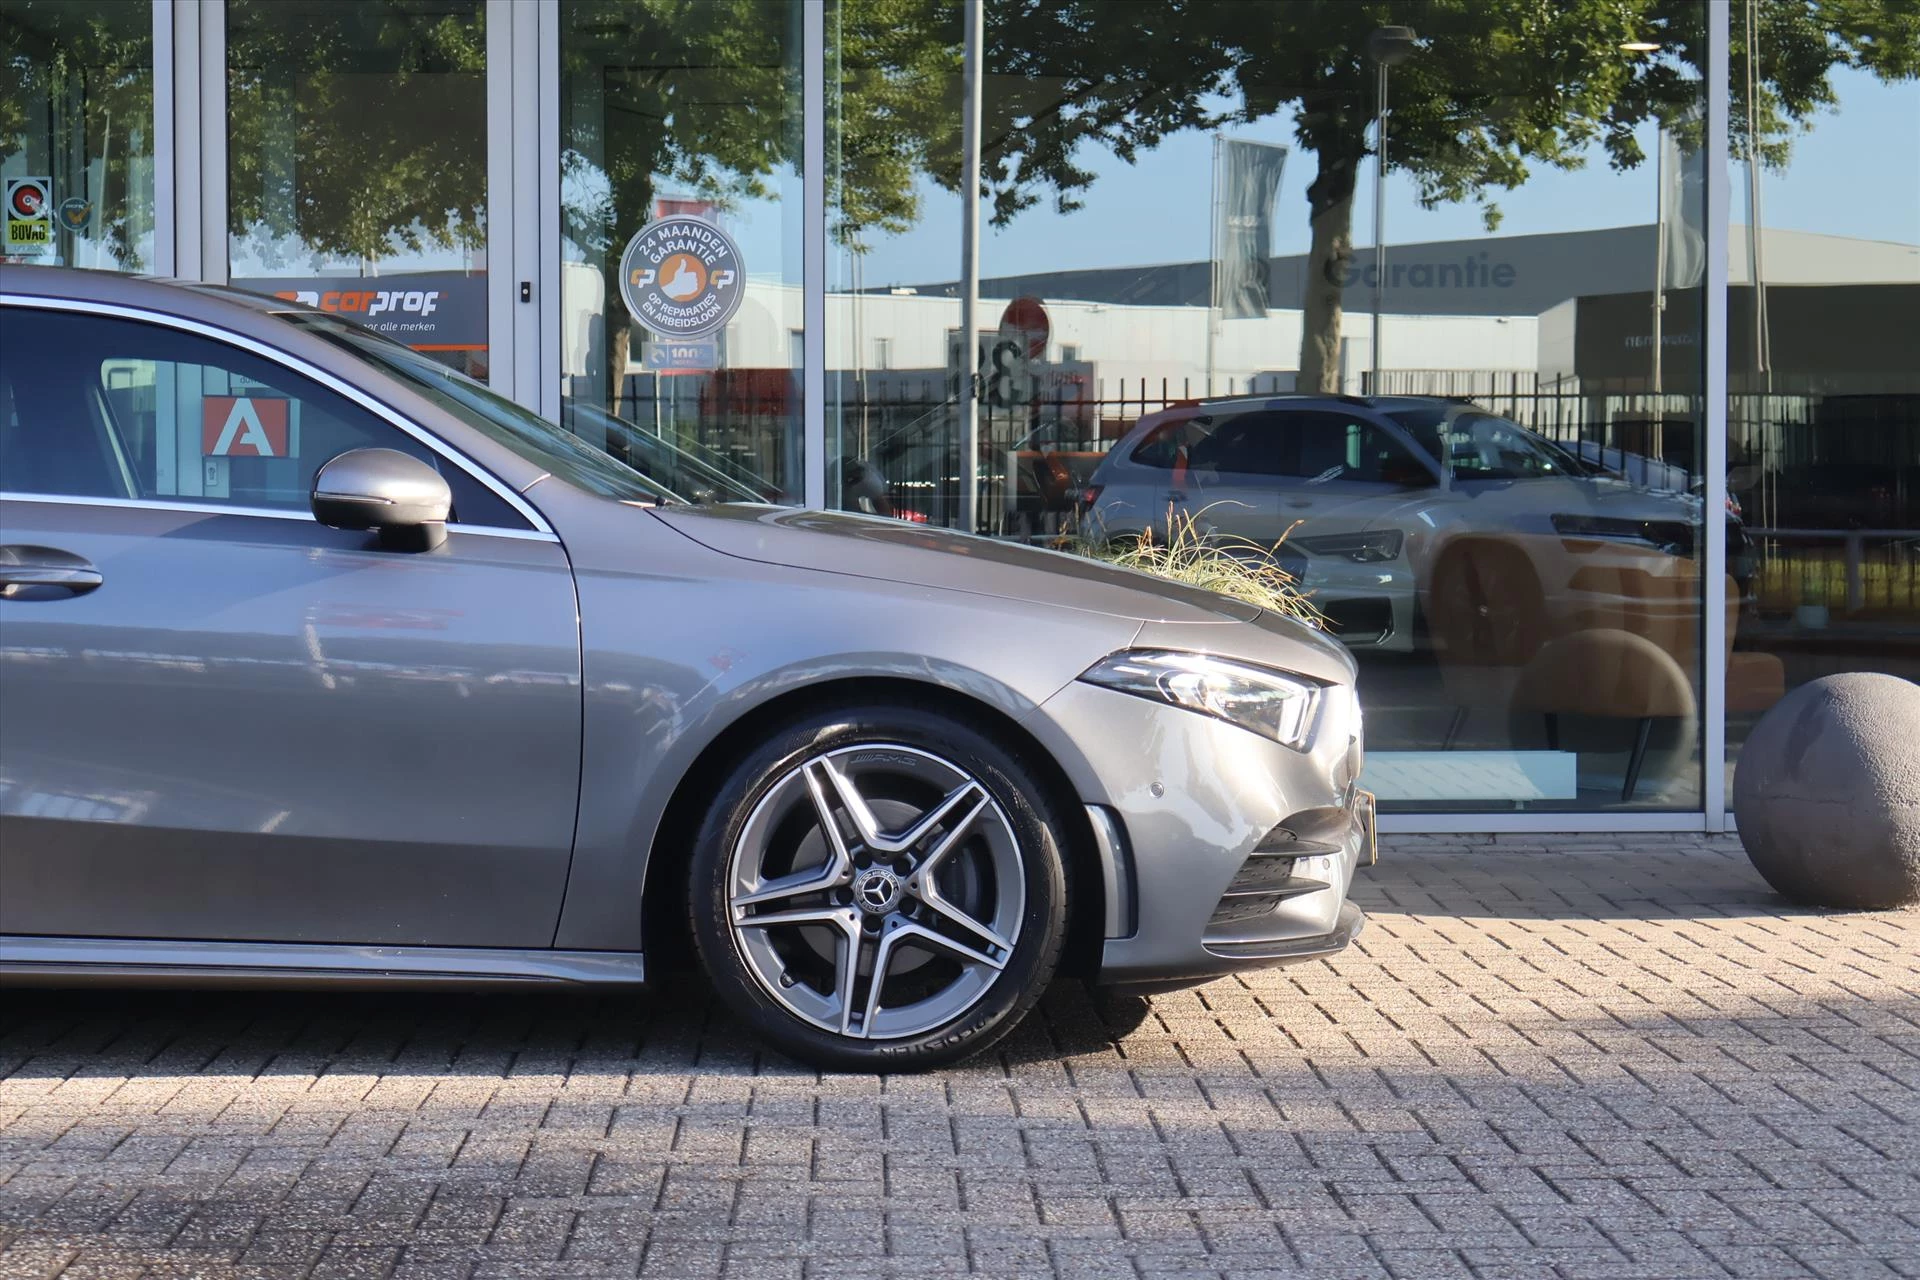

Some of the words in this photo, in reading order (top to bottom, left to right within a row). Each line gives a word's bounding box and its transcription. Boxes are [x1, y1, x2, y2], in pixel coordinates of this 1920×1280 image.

[11, 224, 45, 240] BOVAG
[639, 237, 657, 256] 24
[657, 225, 728, 258] MAANDEN
[650, 239, 716, 266] GARANTIE
[1324, 249, 1517, 288] Garantie
[319, 291, 439, 316] carprof
[642, 302, 656, 317] EN
[654, 301, 722, 328] ARBEIDSLOON
[648, 292, 662, 307] OP
[660, 292, 717, 317] REPARATIES
[380, 321, 397, 332] alle
[400, 321, 436, 332] merken
[212, 398, 274, 456] A
